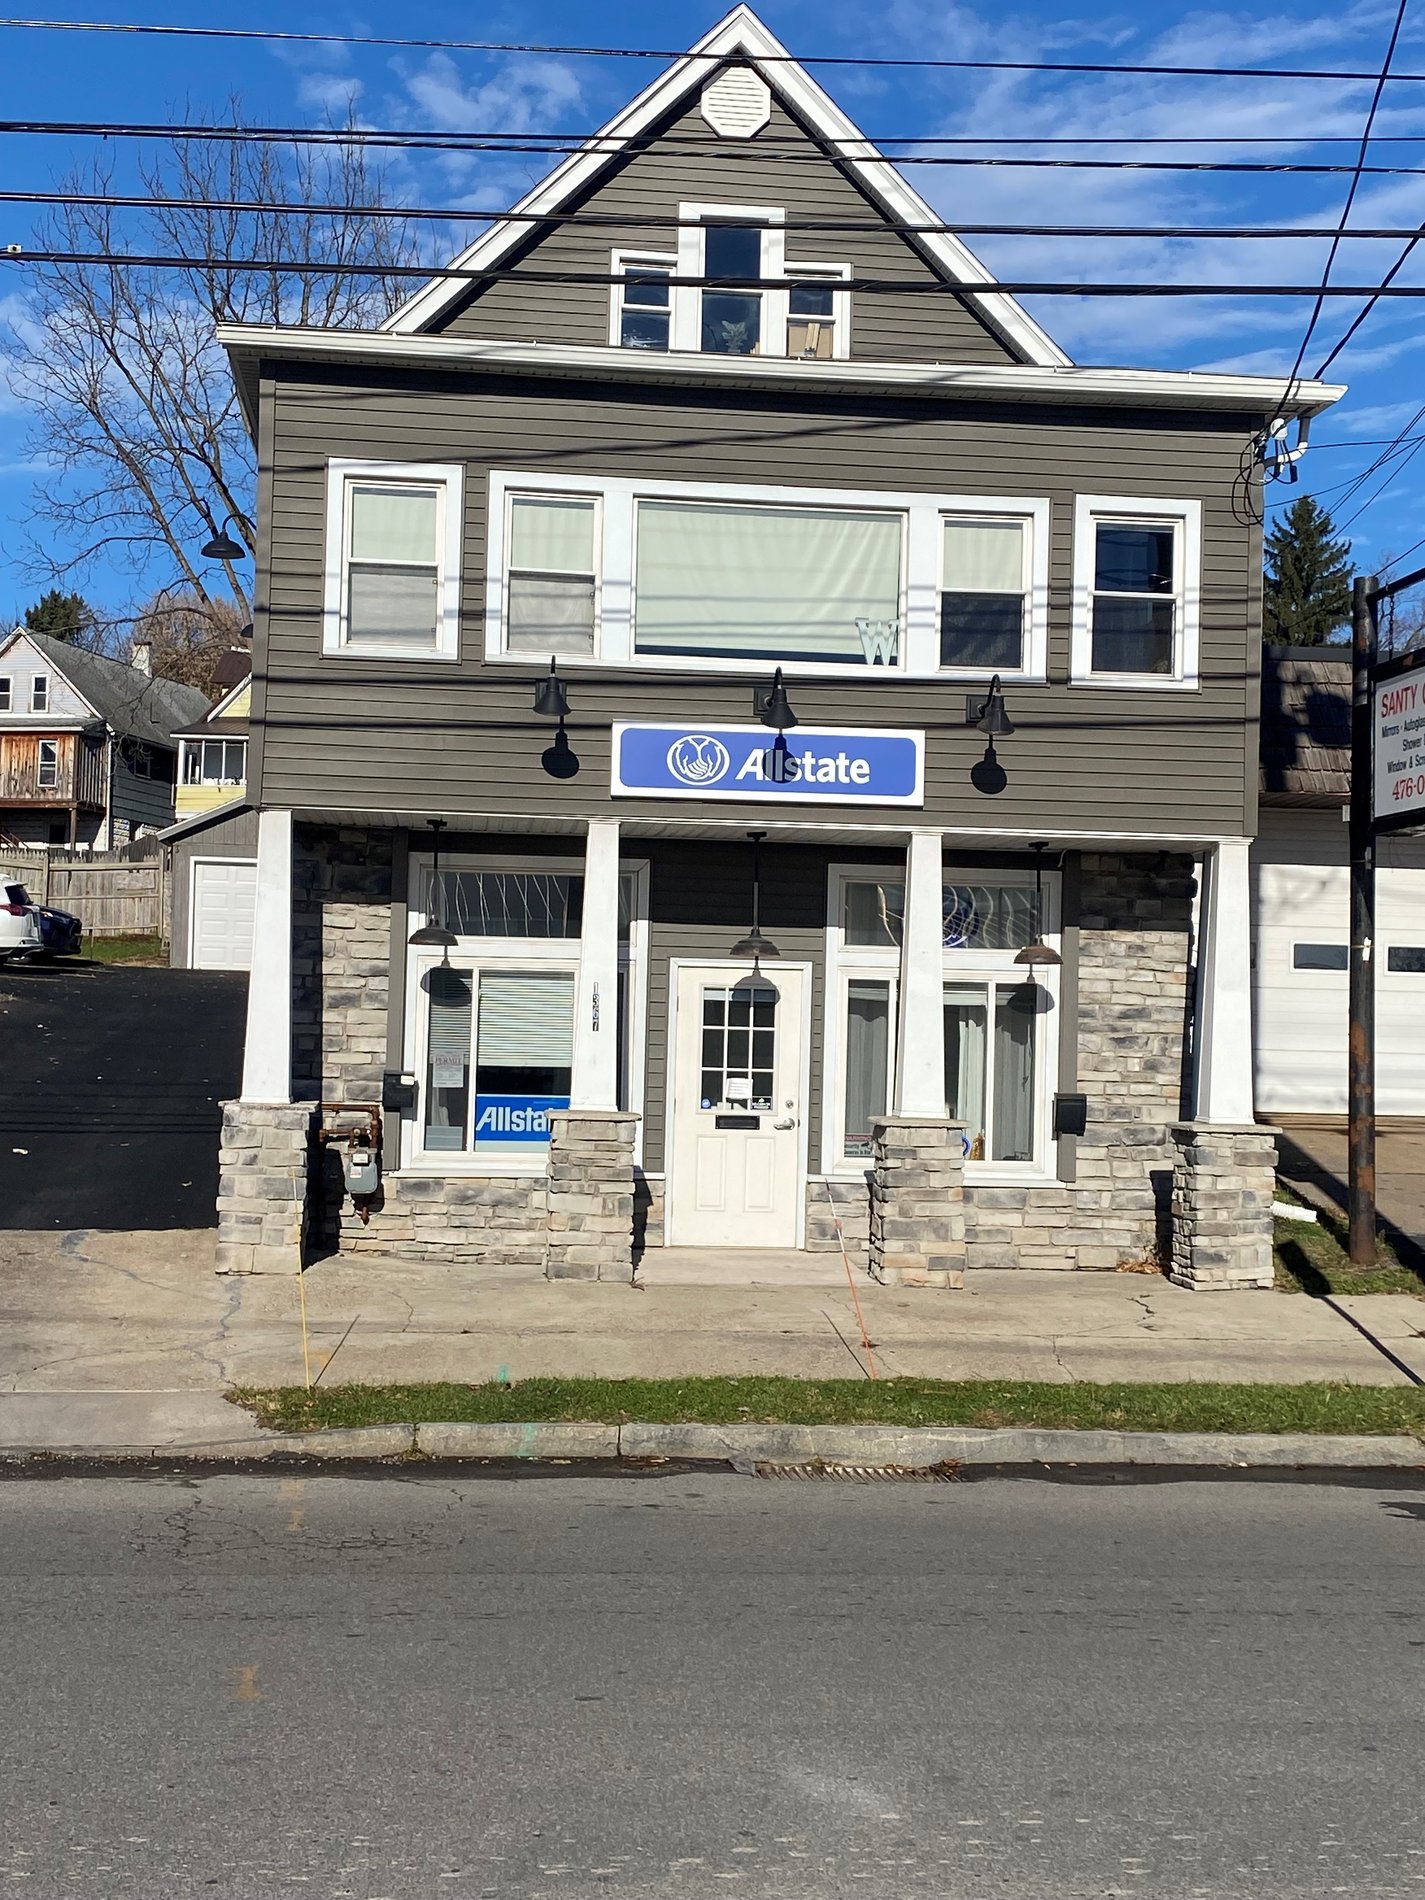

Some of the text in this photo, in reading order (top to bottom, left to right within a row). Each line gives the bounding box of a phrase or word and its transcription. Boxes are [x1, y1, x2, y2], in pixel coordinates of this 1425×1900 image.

[1381, 683, 1418, 718] SANTY
[1382, 725, 1400, 738] Mirrors
[1402, 737, 1422, 751] Shower
[735, 748, 870, 784] Allstate
[1387, 760, 1407, 774] Window
[475, 1106, 550, 1132] Allsta
